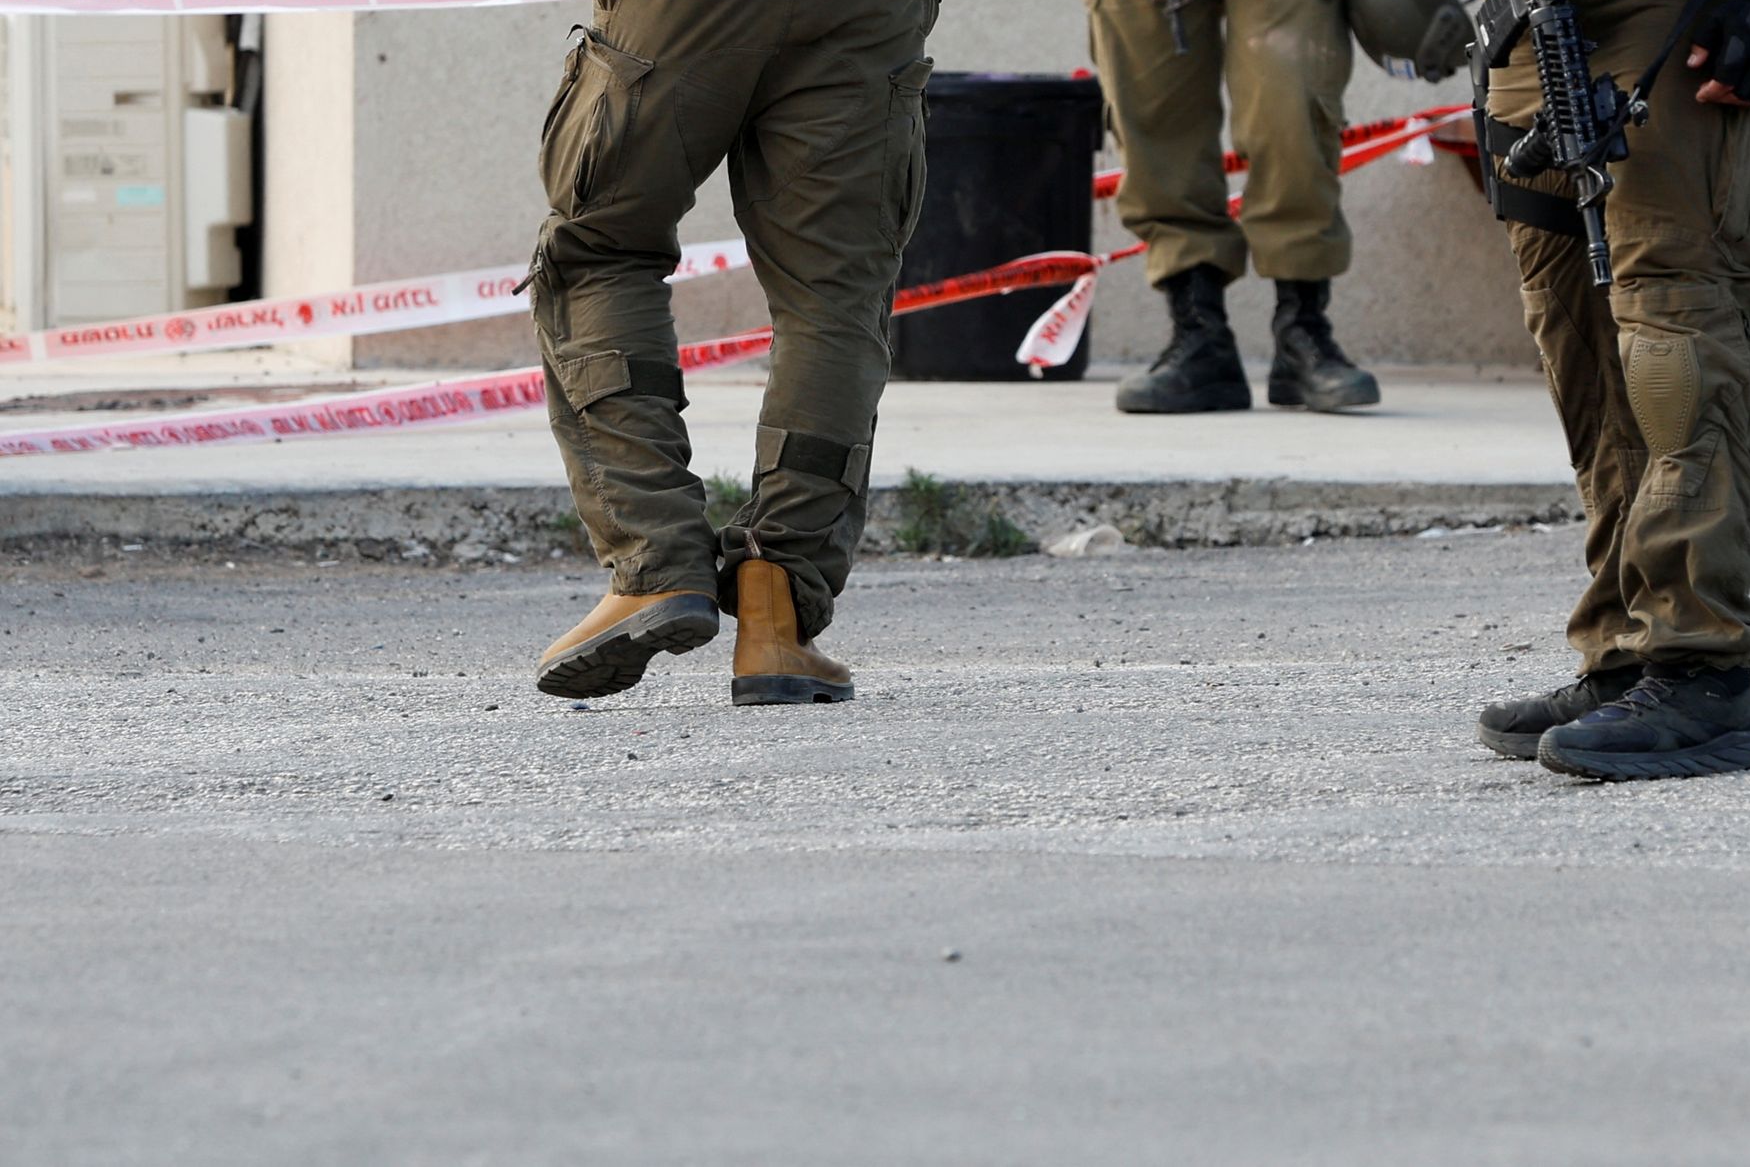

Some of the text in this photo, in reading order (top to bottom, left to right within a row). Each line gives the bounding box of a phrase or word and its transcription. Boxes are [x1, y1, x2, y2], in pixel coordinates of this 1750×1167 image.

[61, 322, 155, 346] משטרת
[331, 292, 365, 317] אין
[373, 287, 441, 313] מעבר
